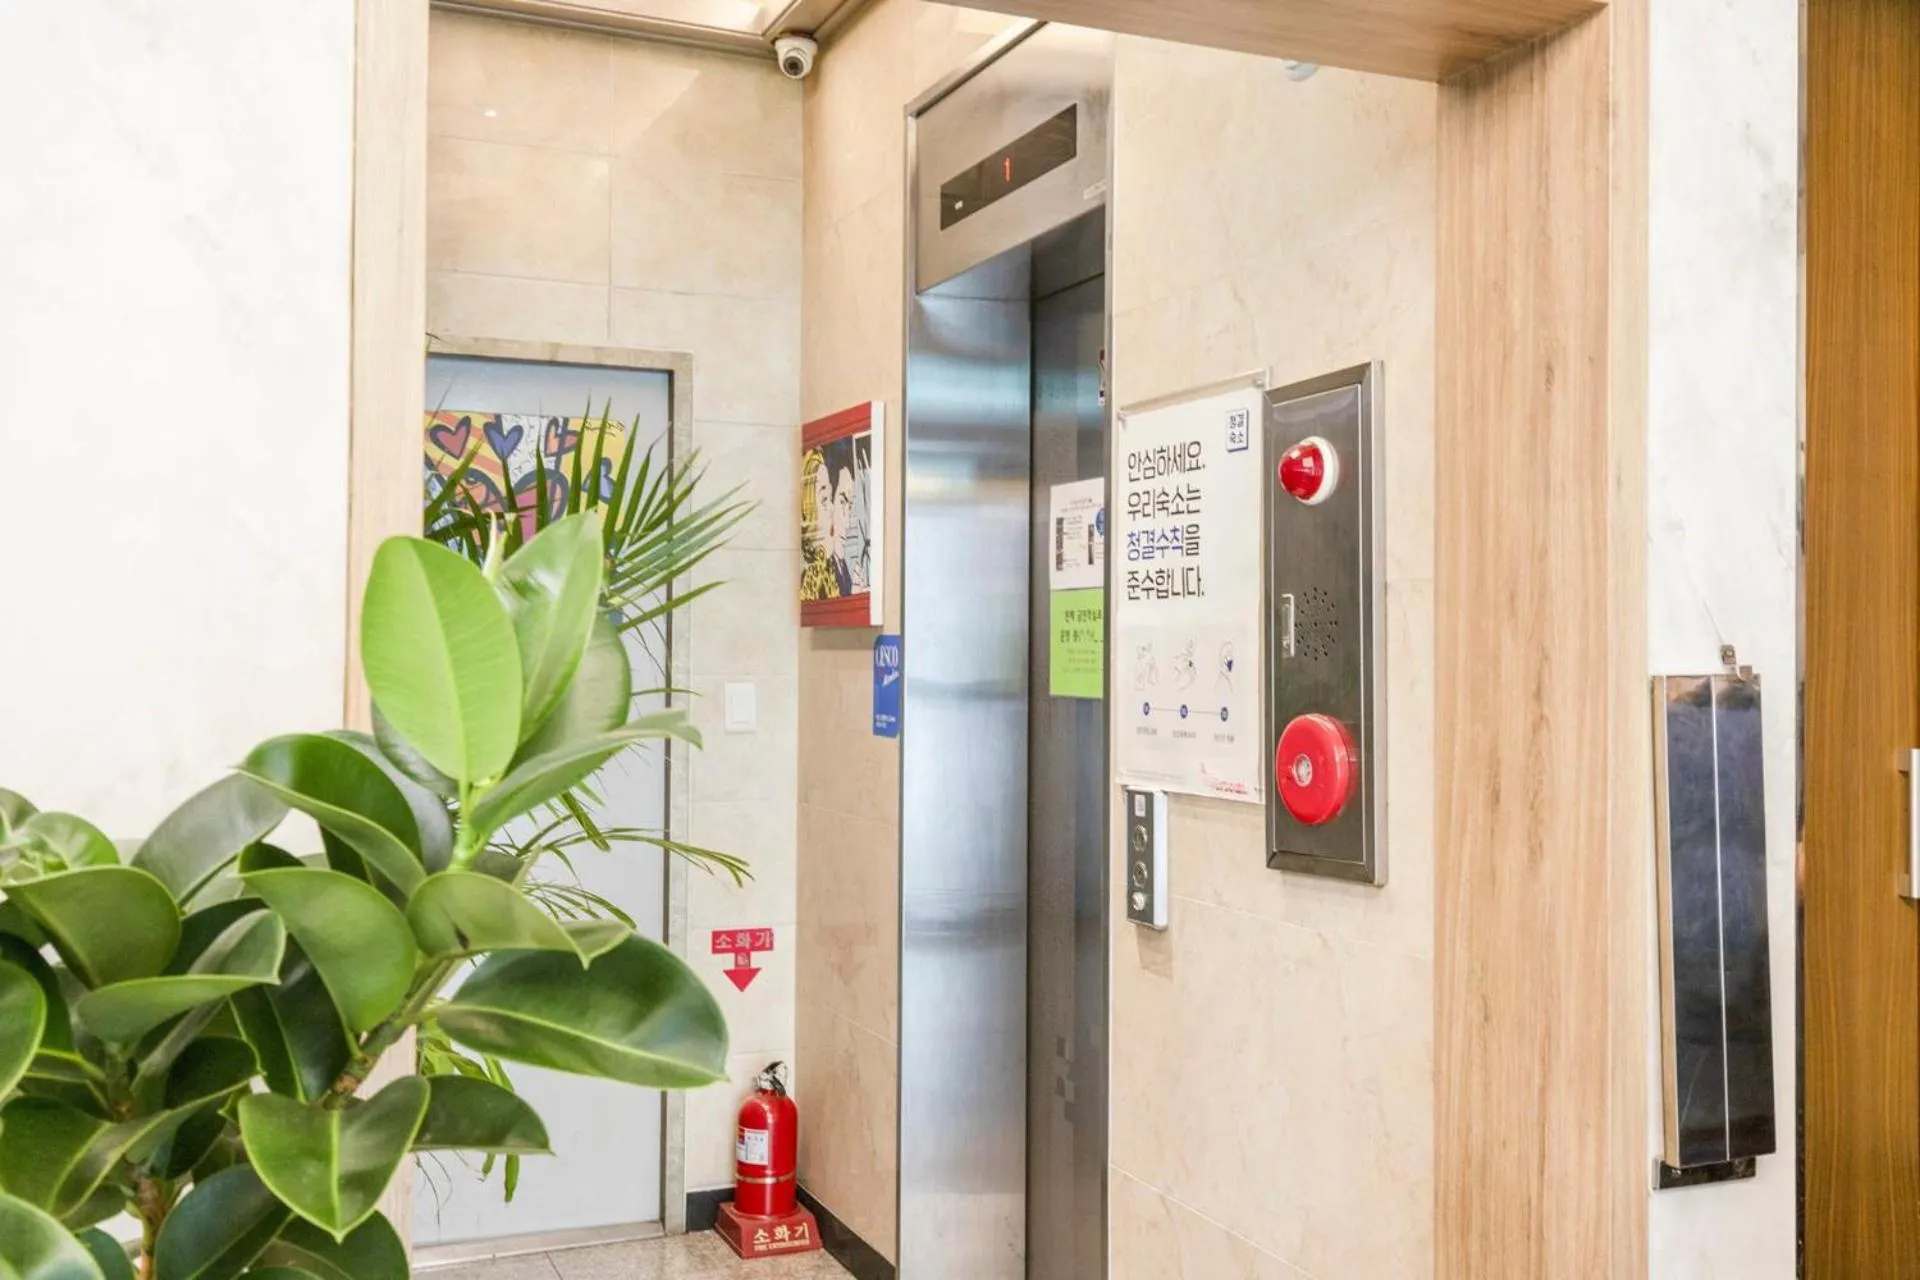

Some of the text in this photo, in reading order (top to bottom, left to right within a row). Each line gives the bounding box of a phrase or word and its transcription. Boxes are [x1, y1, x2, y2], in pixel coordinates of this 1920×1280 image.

[1004, 156, 1011, 182] 1
[1128, 440, 1205, 482] 안심하세요.
[1127, 482, 1202, 521] 우리숙소는
[1127, 524, 1200, 561] 청결수칙을
[1127, 565, 1204, 600] 준수합니다.
[715, 930, 771, 950] 소화기
[752, 1222, 810, 1244] 소화기
